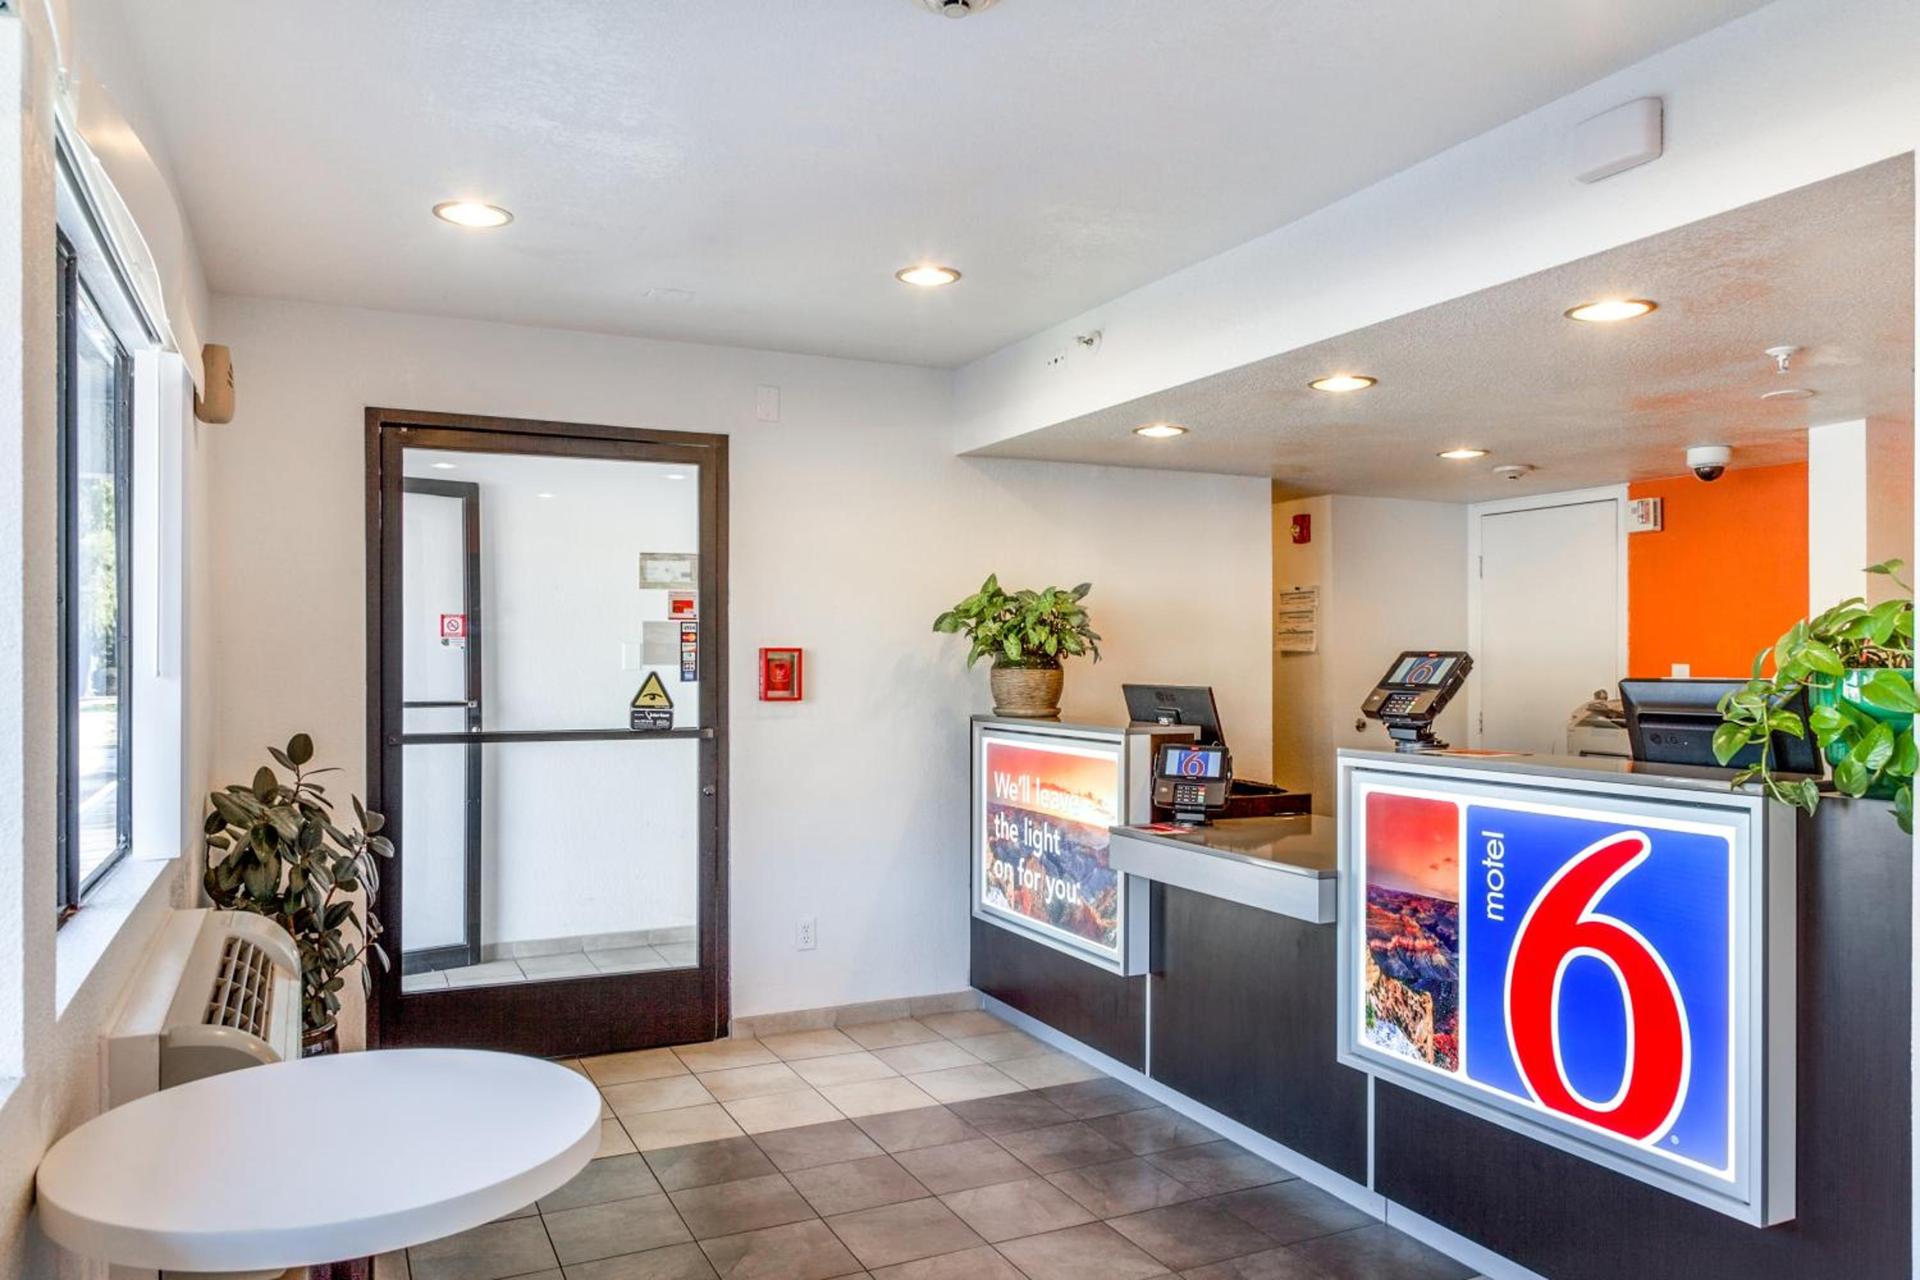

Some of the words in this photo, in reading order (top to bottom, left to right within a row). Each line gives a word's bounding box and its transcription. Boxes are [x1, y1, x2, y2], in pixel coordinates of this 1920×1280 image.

[1407, 657, 1439, 684] 6
[1183, 752, 1205, 777] 6
[993, 771, 1030, 804] We'll
[994, 811, 1019, 843] the
[1024, 817, 1061, 857] light
[994, 859, 1014, 882] on
[1017, 857, 1041, 891] for
[1482, 831, 1505, 922] motel
[1504, 830, 1691, 1145] 6
